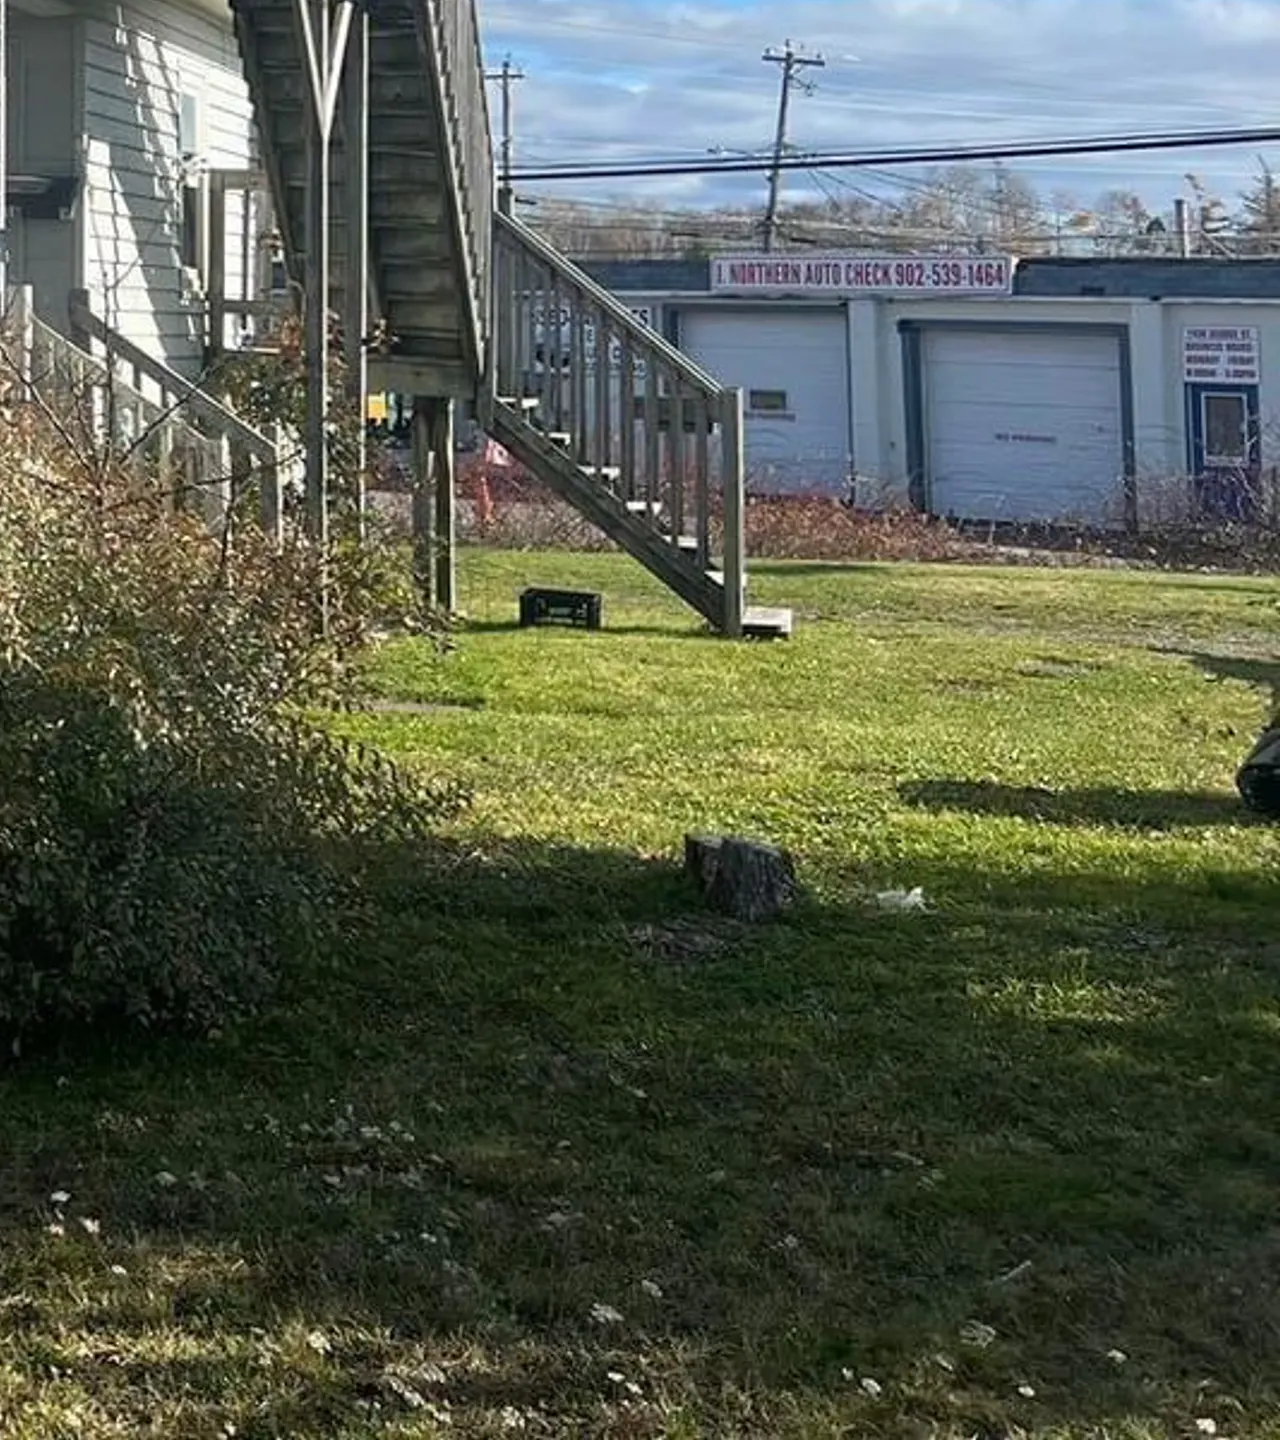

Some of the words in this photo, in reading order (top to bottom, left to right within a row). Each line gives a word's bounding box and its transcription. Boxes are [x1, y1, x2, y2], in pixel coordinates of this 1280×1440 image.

[730, 262, 801, 285] NORTHERN
[804, 262, 842, 286] AUTO
[845, 262, 891, 286] CHECK
[895, 262, 1003, 287] 902-539-1464
